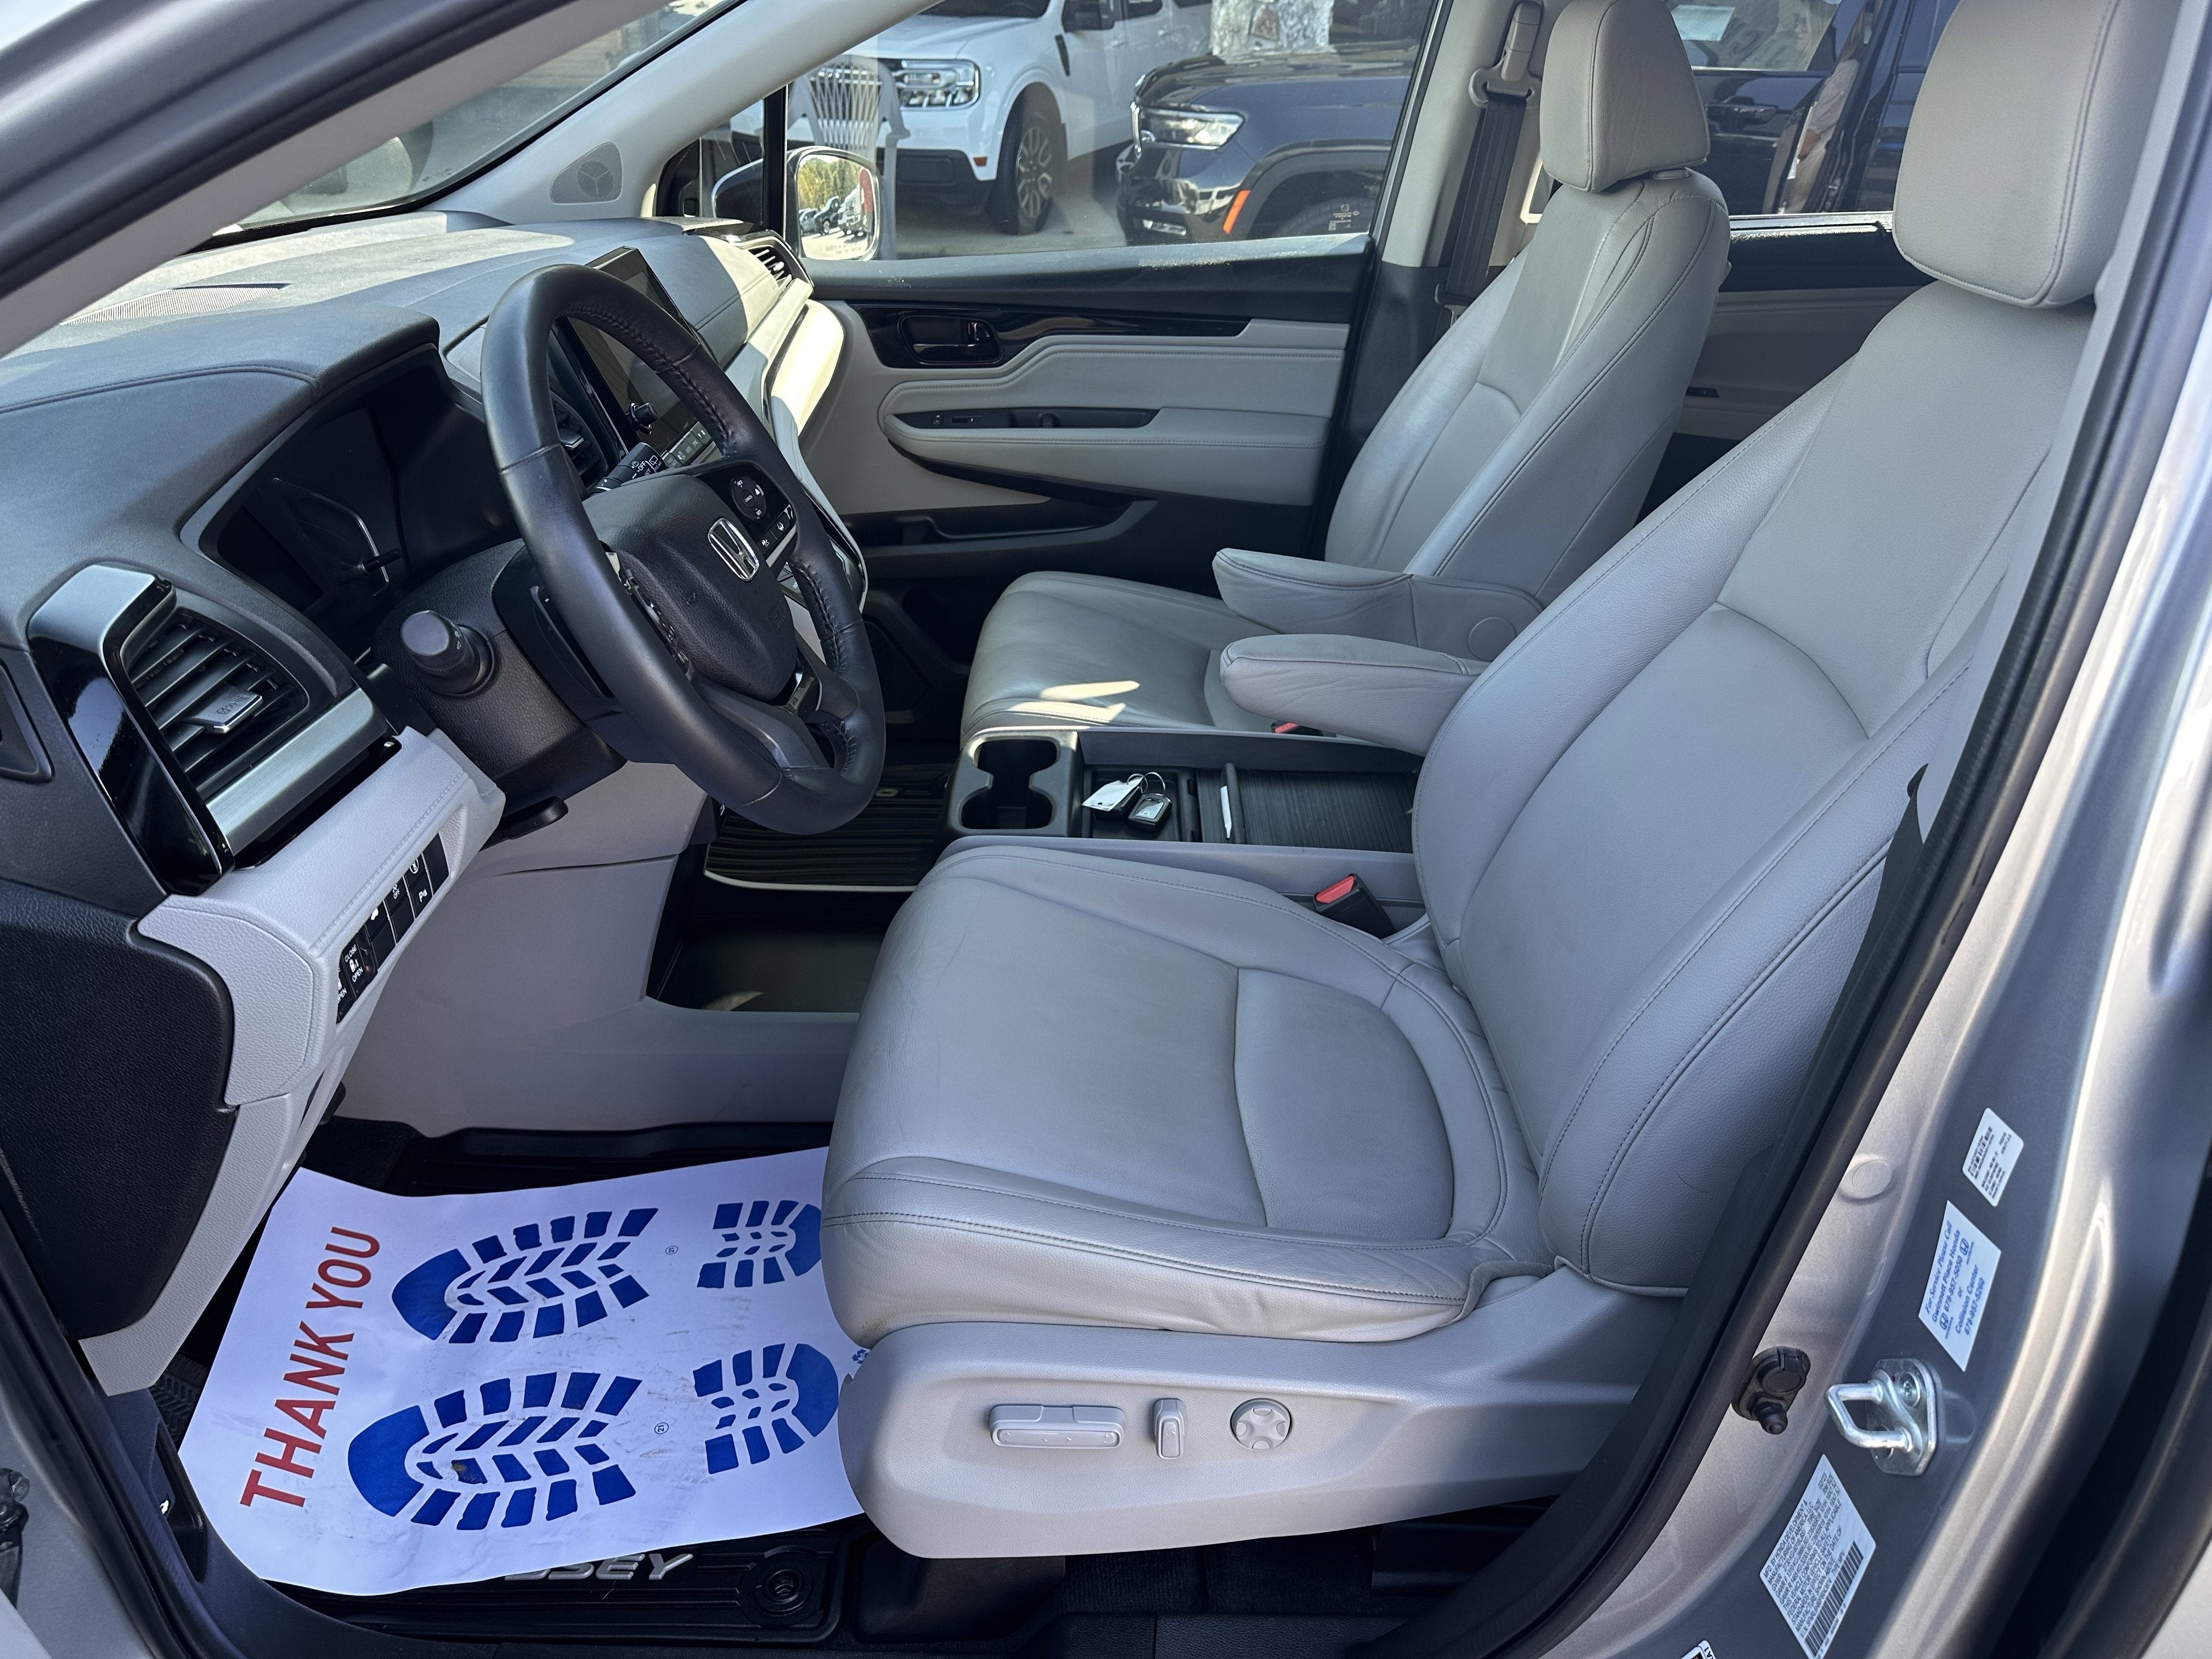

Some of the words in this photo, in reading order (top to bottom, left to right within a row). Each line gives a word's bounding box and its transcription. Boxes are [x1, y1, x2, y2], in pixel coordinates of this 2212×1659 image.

[345, 944, 357, 962] CLOSE
[352, 967, 363, 982] OPEN
[1929, 1267, 1940, 1298] Service
[1937, 1240, 1947, 1268] Please
[1932, 1283, 1946, 1322] Gwinnett
[1942, 1259, 1953, 1284] Place
[1949, 1229, 1960, 1259] Honda
[1955, 1295, 1970, 1334] Collision
[1966, 1264, 1978, 1294] Center
[1957, 1286, 1962, 1297] or
[240, 1321, 354, 1506] THANK
[305, 1227, 381, 1309] YOU
[1770, 1556, 1776, 1566] BY
[1774, 1539, 1786, 1559] HONDA
[1784, 1503, 1805, 1542] DEVELOPMENT
[1807, 1510, 1815, 1524] TIRE
[1813, 1498, 1821, 1513] SIZE
[1767, 1542, 1792, 1585] MANUFACTURING
[1790, 1534, 1795, 1544] OF
[1782, 1596, 1792, 1610] THIS
[1790, 1575, 1803, 1599] VEHICLE
[1801, 1547, 1818, 1578] CONFORMS
[1815, 1539, 1821, 1549] TO
[1824, 1498, 1841, 1532] APPLICABLE
[1787, 1595, 1802, 1618] FEDERAL
[1799, 1574, 1811, 1595] MOTOR
[1809, 1552, 1822, 1576] VEHICLE
[1820, 1533, 1831, 1555] SAFETY
[1791, 1593, 1809, 1625] STANDARDS
[1807, 1587, 1812, 1595] IN
[1810, 1566, 1821, 1590] EFFECT
[1820, 1559, 1826, 1570] ON
[1824, 1547, 1832, 1561] THE
[1829, 1533, 1838, 1551] DATE
[1836, 1525, 1841, 1536] OF
[1775, 1579, 1786, 1598] GAWR
[1779, 1587, 1790, 1604] GAWR
[1795, 1592, 1816, 1632] MANUFACTURE
[1814, 1574, 1826, 1595] SHOWN
[1824, 1555, 1835, 1576] ABOVE
